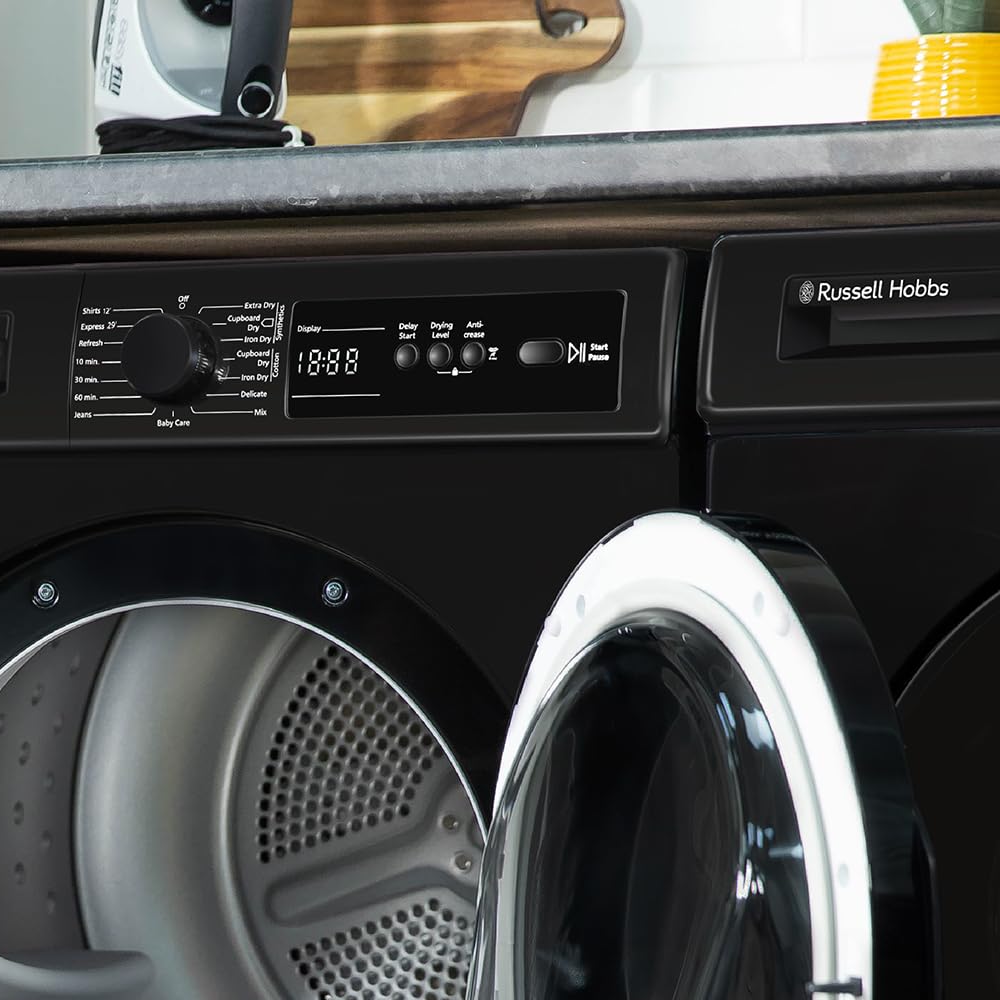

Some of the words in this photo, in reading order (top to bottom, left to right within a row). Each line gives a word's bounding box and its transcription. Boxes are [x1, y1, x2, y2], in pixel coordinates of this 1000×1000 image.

[817, 280, 883, 302] Russell
[889, 278, 950, 299] Hobbs
[177, 295, 190, 303] Off
[82, 307, 101, 315] Shirts
[244, 302, 262, 310] Extra
[264, 302, 276, 312] Dry
[227, 314, 261, 324] Cupboard
[275, 304, 286, 341] Synthetics
[80, 322, 105, 332] Express
[247, 324, 260, 333] Dry
[297, 324, 322, 334] Display
[398, 321, 419, 333] Delay
[430, 321, 454, 332] Drying
[244, 335, 258, 343] Iron
[259, 335, 272, 345] Dry
[399, 331, 416, 340] Start
[431, 330, 450, 340] Level
[463, 331, 485, 339] crease
[78, 338, 104, 347] Refresh
[590, 342, 609, 352] Start
[236, 349, 271, 359] Cupboard
[588, 352, 610, 362] Pause
[76, 357, 84, 366] 10
[257, 359, 270, 368] Dry
[271, 352, 281, 378] Cotton
[74, 376, 84, 385] 30
[241, 373, 255, 382] Iron
[256, 373, 269, 383] Dry
[74, 393, 83, 402] 60
[240, 389, 268, 399] Delicate
[74, 410, 93, 420] Jeans
[254, 408, 268, 417] Mix
[157, 418, 174, 429] Baby
[175, 418, 191, 427] Care
